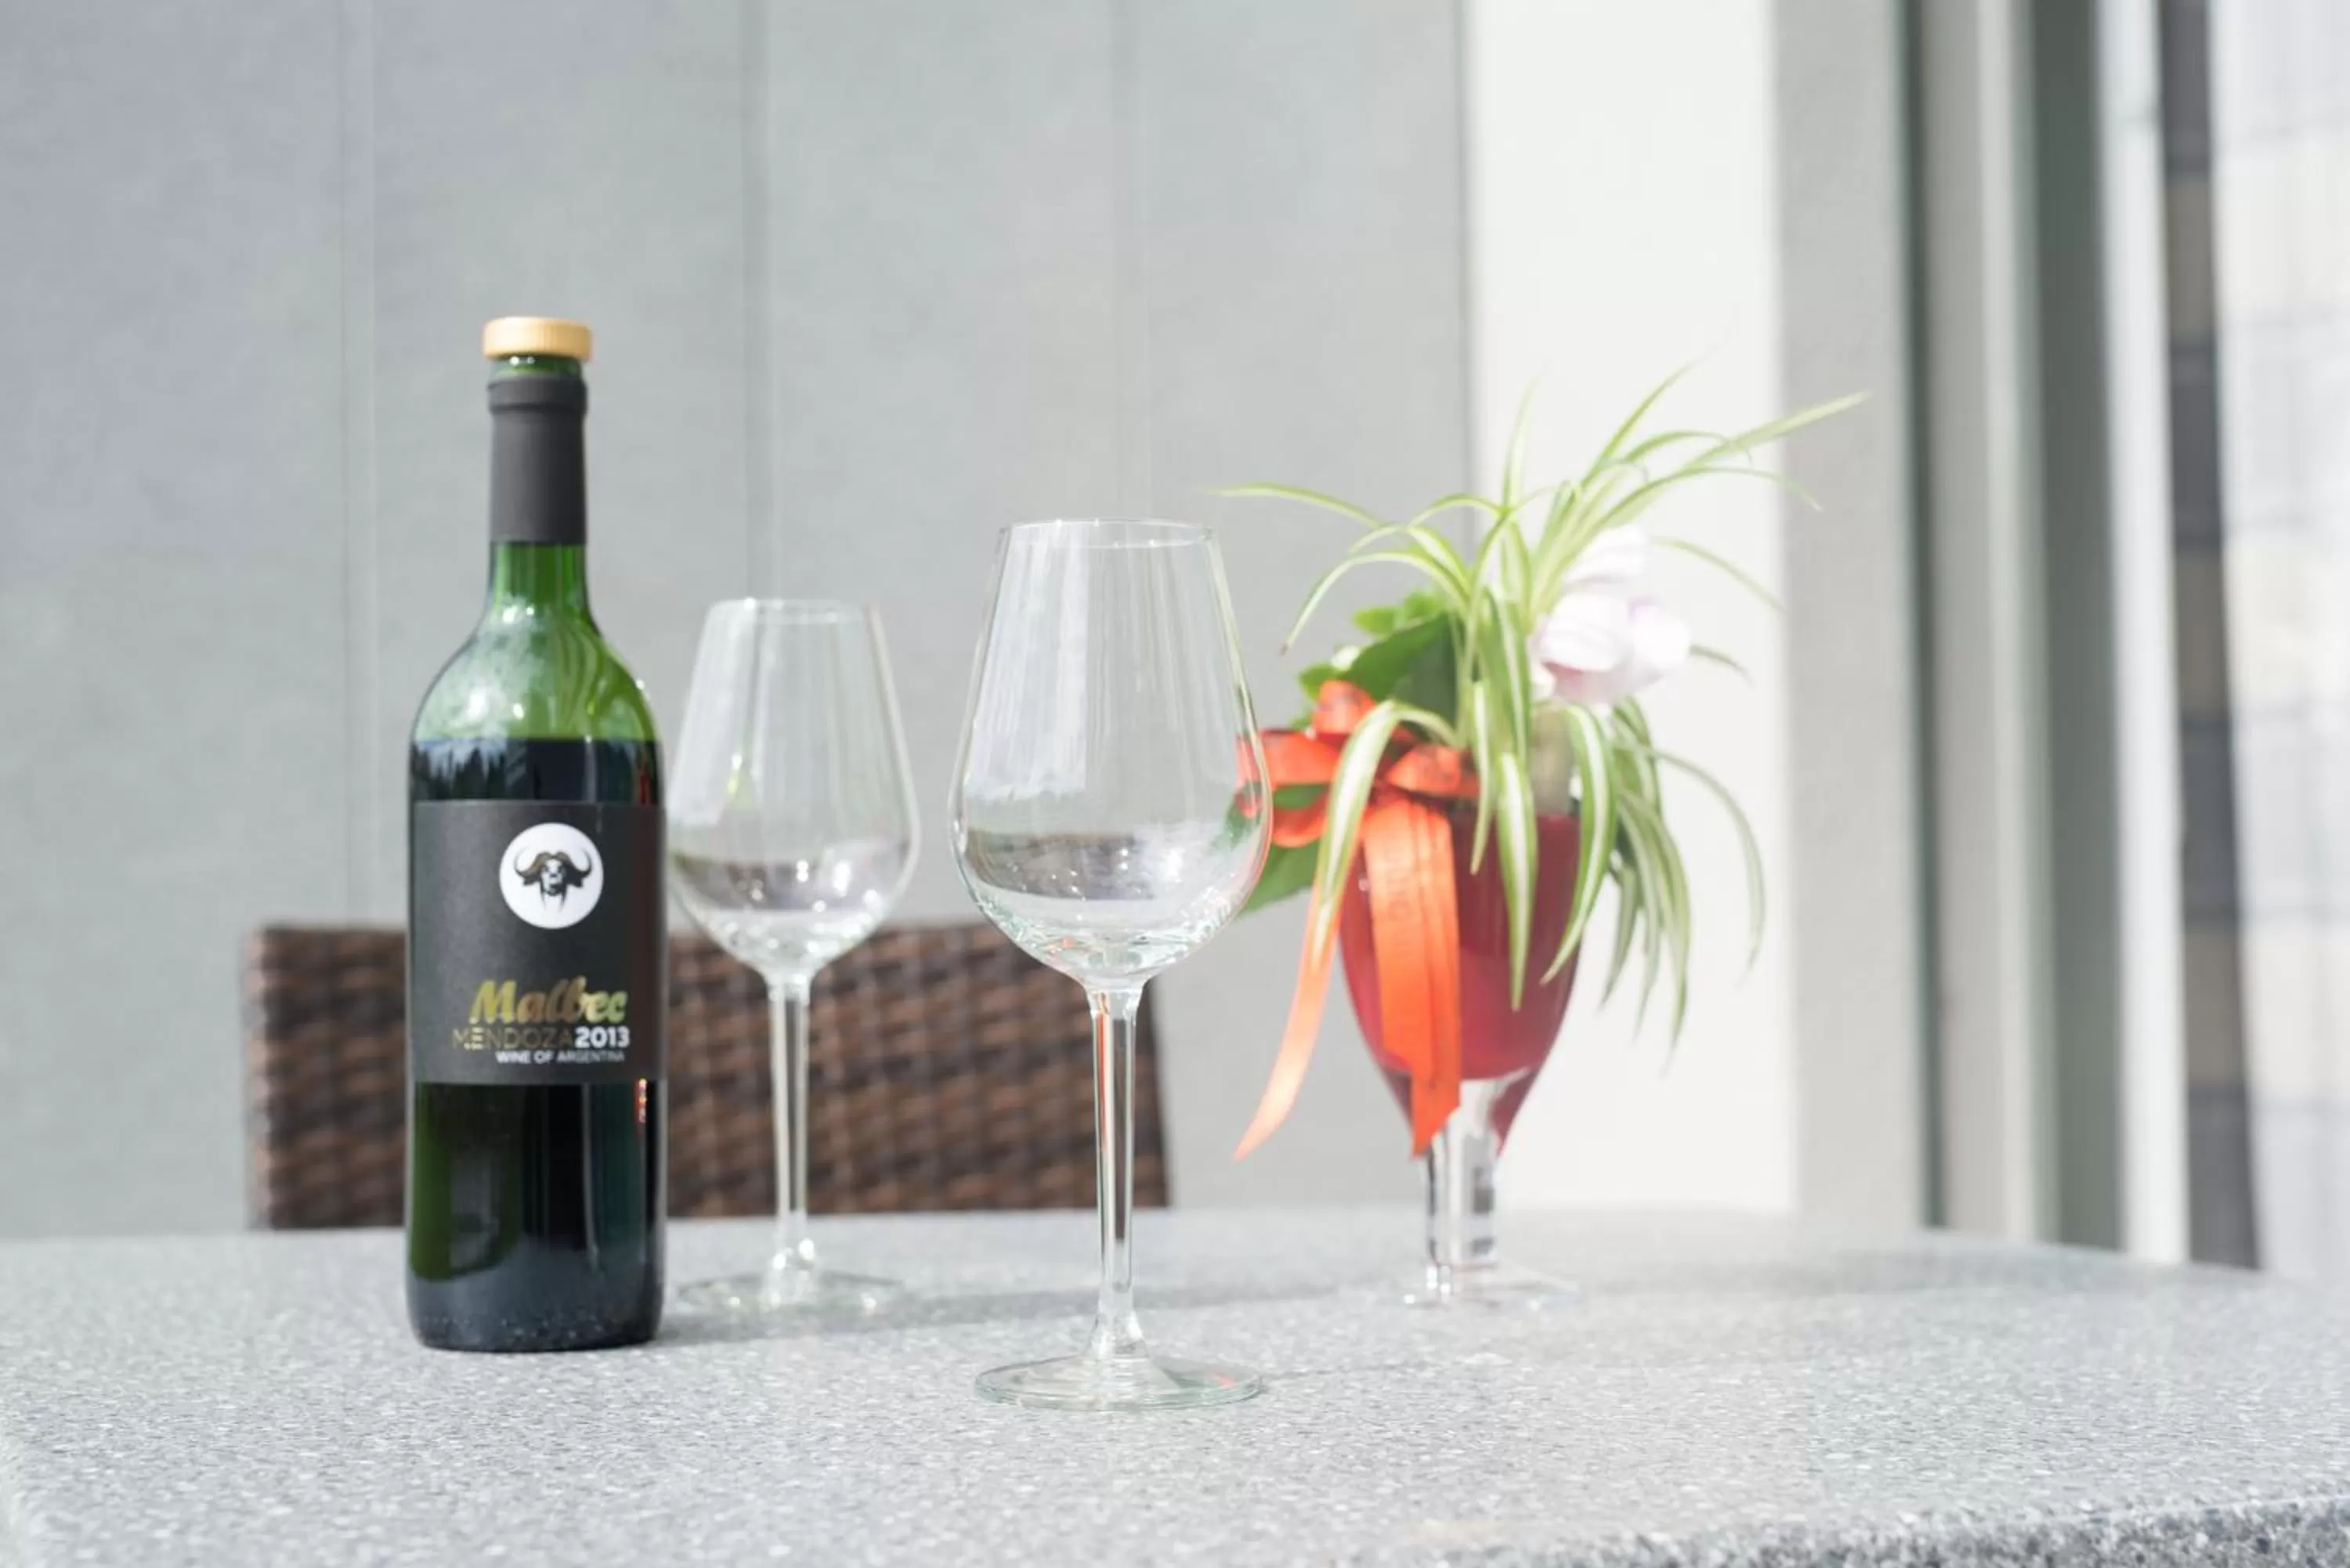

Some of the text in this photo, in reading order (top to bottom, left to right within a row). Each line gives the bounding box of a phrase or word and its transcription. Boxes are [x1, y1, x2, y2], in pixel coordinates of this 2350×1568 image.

[468, 975, 627, 1024] Malbec
[451, 1026, 631, 1050] MENDOZA 2013
[495, 1050, 530, 1064] WINE
[533, 1050, 554, 1064] OF
